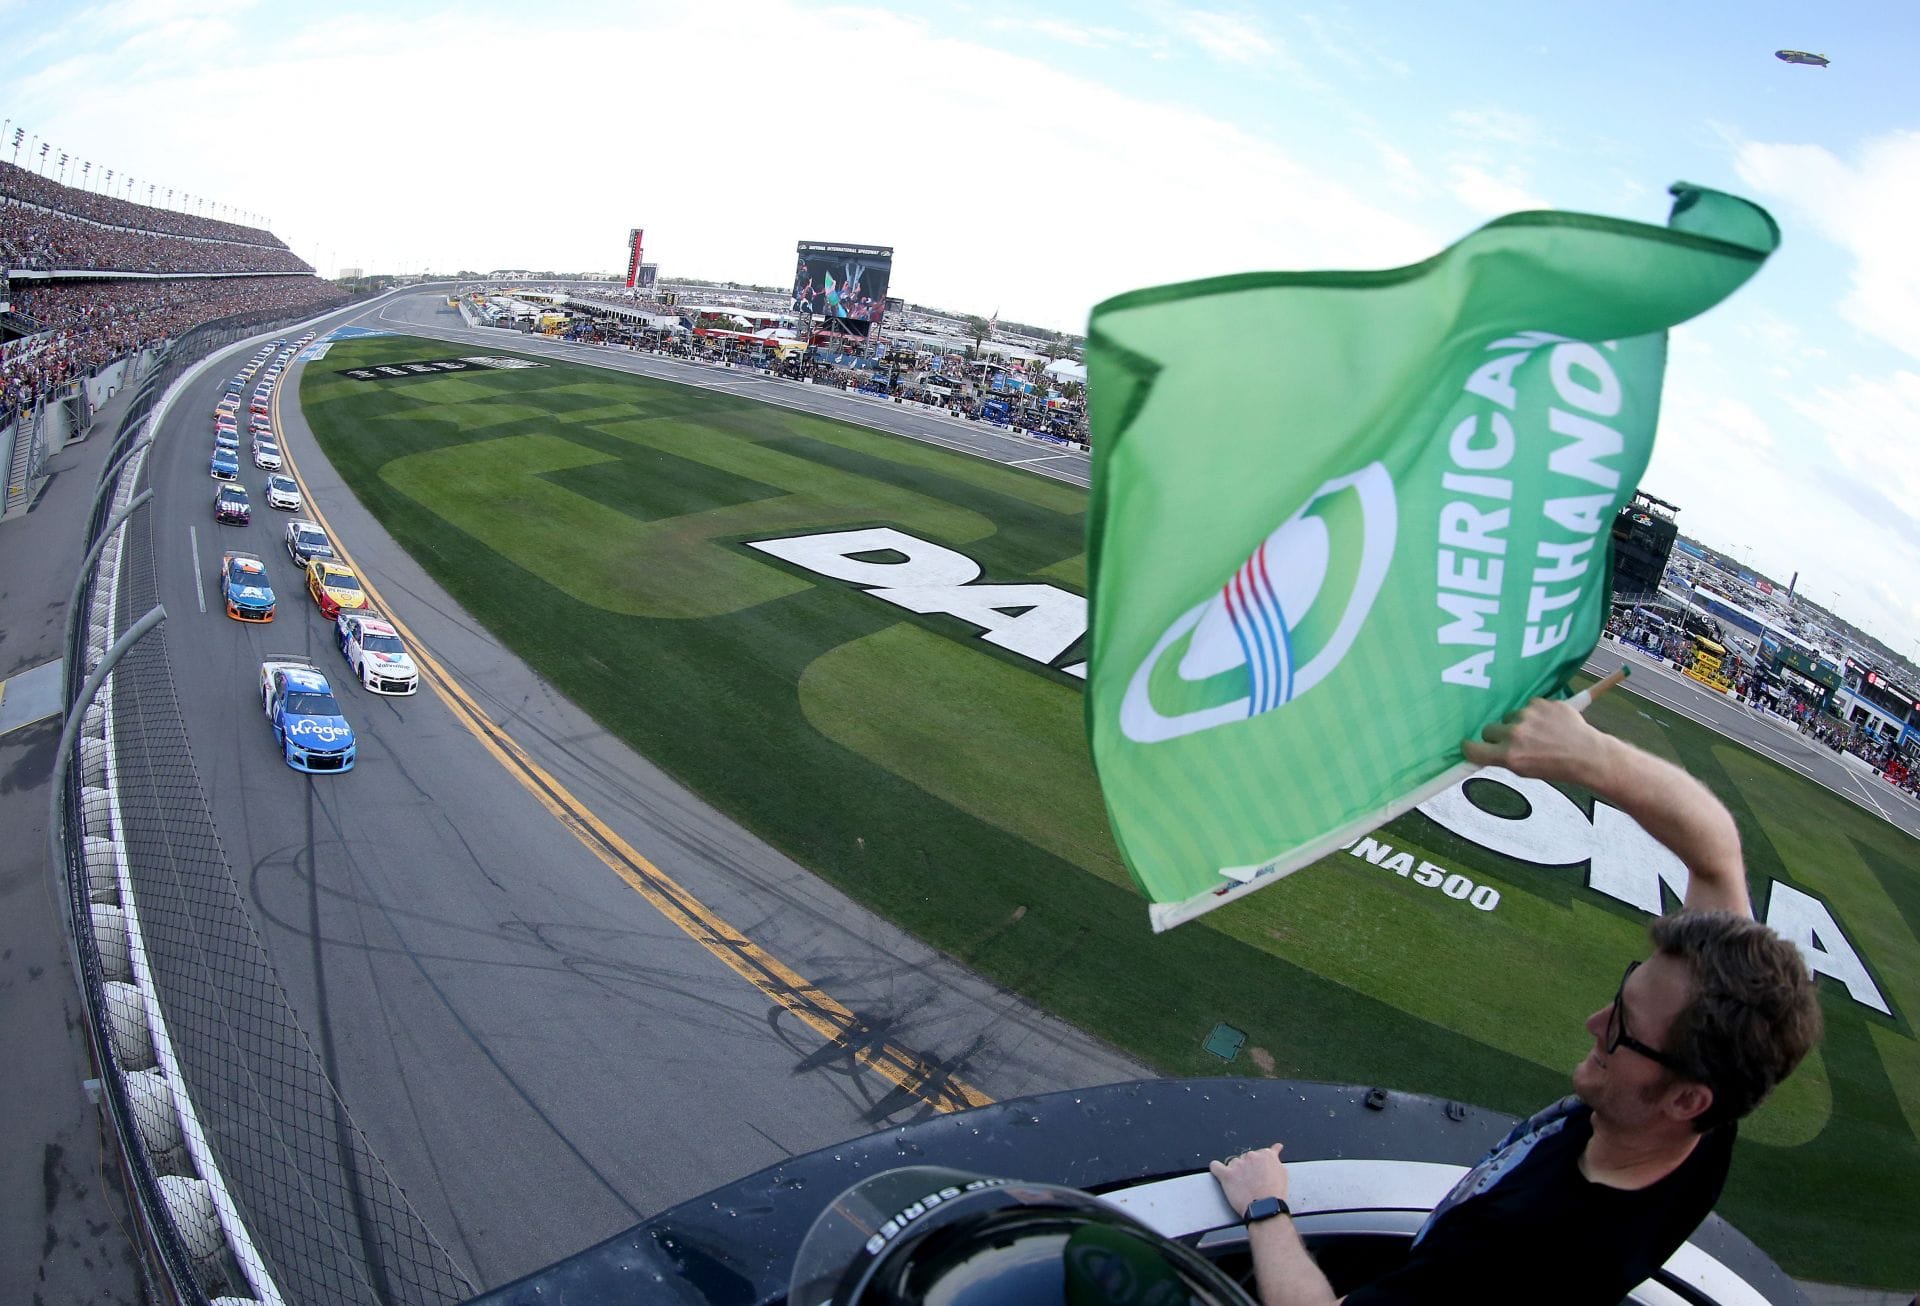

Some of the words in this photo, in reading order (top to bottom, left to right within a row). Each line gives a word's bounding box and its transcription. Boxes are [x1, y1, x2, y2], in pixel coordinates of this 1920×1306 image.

[222, 501, 250, 513] ally
[1521, 340, 1624, 658] ETHANO
[291, 719, 349, 742] Kroger
[1341, 836, 1501, 911] NA500
[966, 1178, 1006, 1191] UP
[866, 1186, 961, 1255] SERIES
